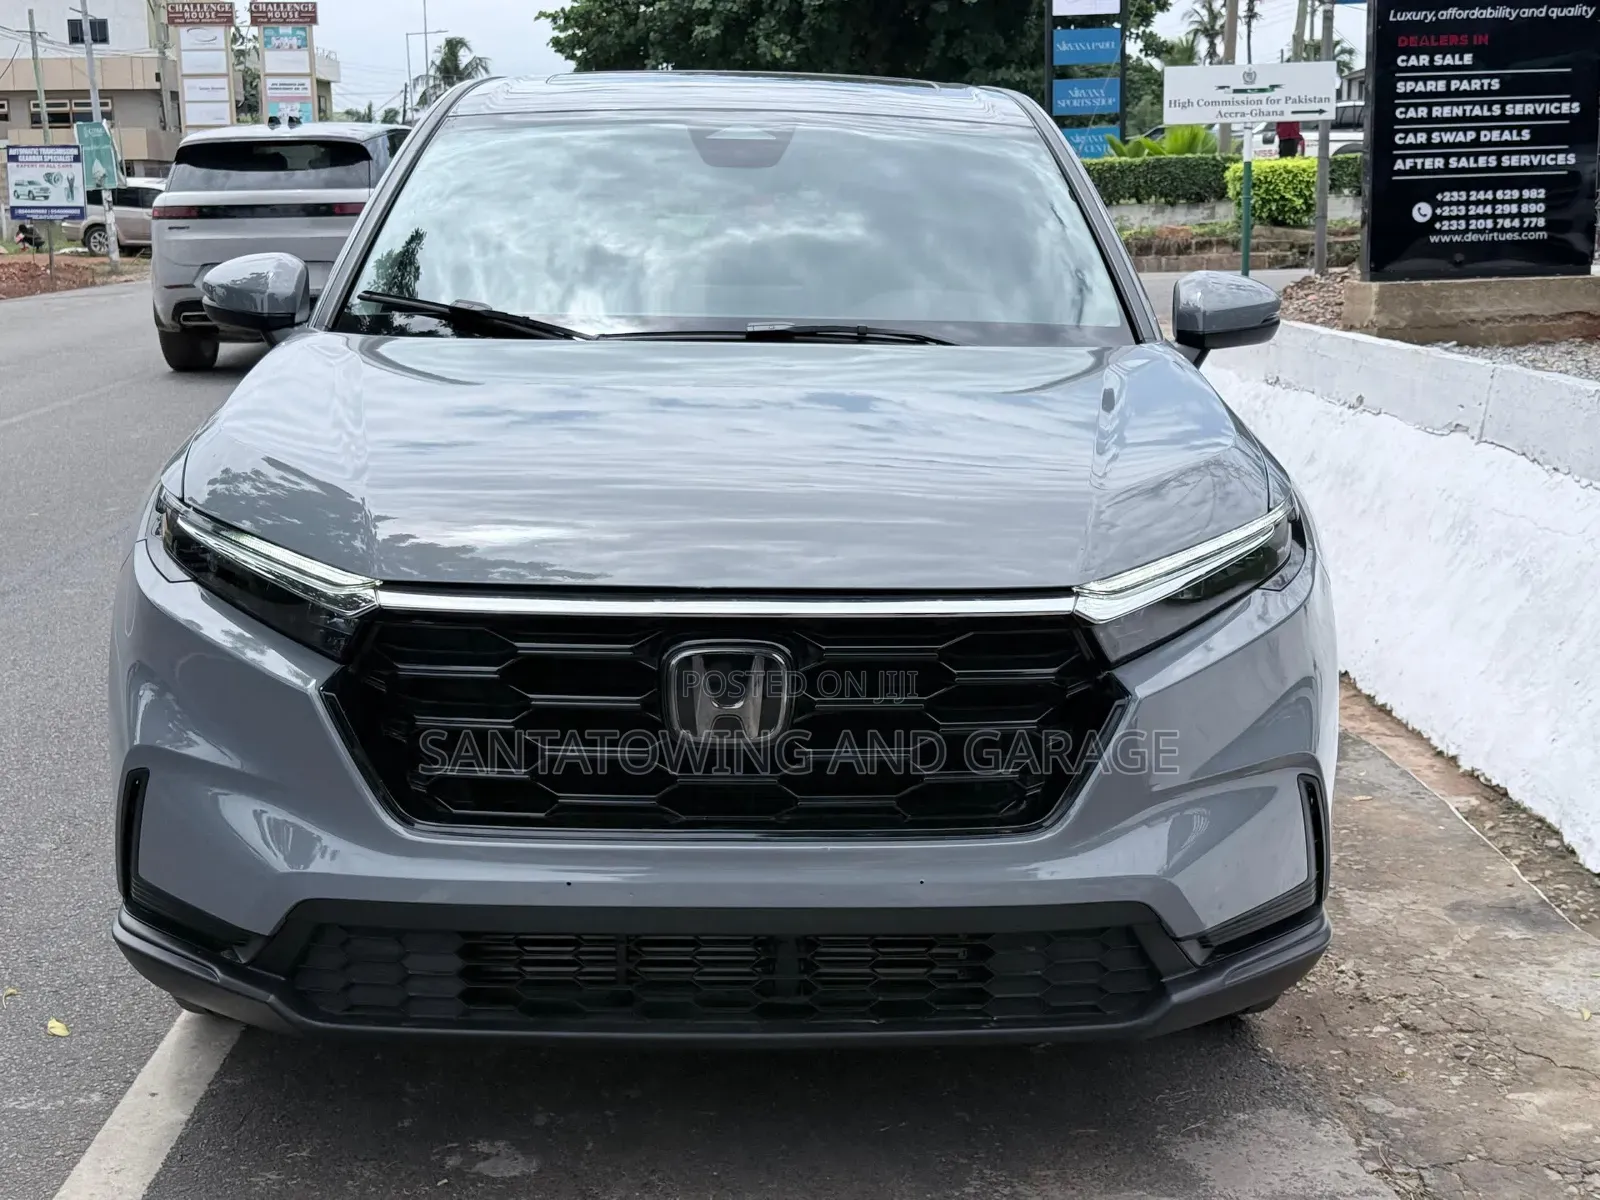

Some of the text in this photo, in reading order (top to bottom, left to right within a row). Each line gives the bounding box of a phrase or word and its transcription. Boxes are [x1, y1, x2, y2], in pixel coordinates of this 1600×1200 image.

[168, 3, 232, 12] CHALLENGE
[251, 3, 315, 12] CHALLENGE
[1389, 4, 1596, 23] Luxury, affordability and quality
[1398, 34, 1489, 47] DEALERS IN
[1397, 53, 1474, 67] CAR SALE
[1396, 78, 1500, 93] SPARE PARTS
[1168, 94, 1331, 110] High Commission for Pakistan
[1216, 107, 1284, 119] Accra-Ghana
[1395, 102, 1580, 119] CAR RENTALS SERVICES
[1394, 129, 1531, 144] CAR SWAP DEALS
[1393, 153, 1576, 170] AFTER SALES SERVICES
[1436, 188, 1546, 201] +233 244 629 982
[1435, 205, 1466, 216] +233
[1468, 204, 1493, 215] 244
[1520, 203, 1546, 213] 890
[1434, 220, 1466, 230] +233
[1496, 218, 1520, 229] 764
[1522, 217, 1546, 228] 778
[1429, 230, 1548, 243] www.devirtues.com
